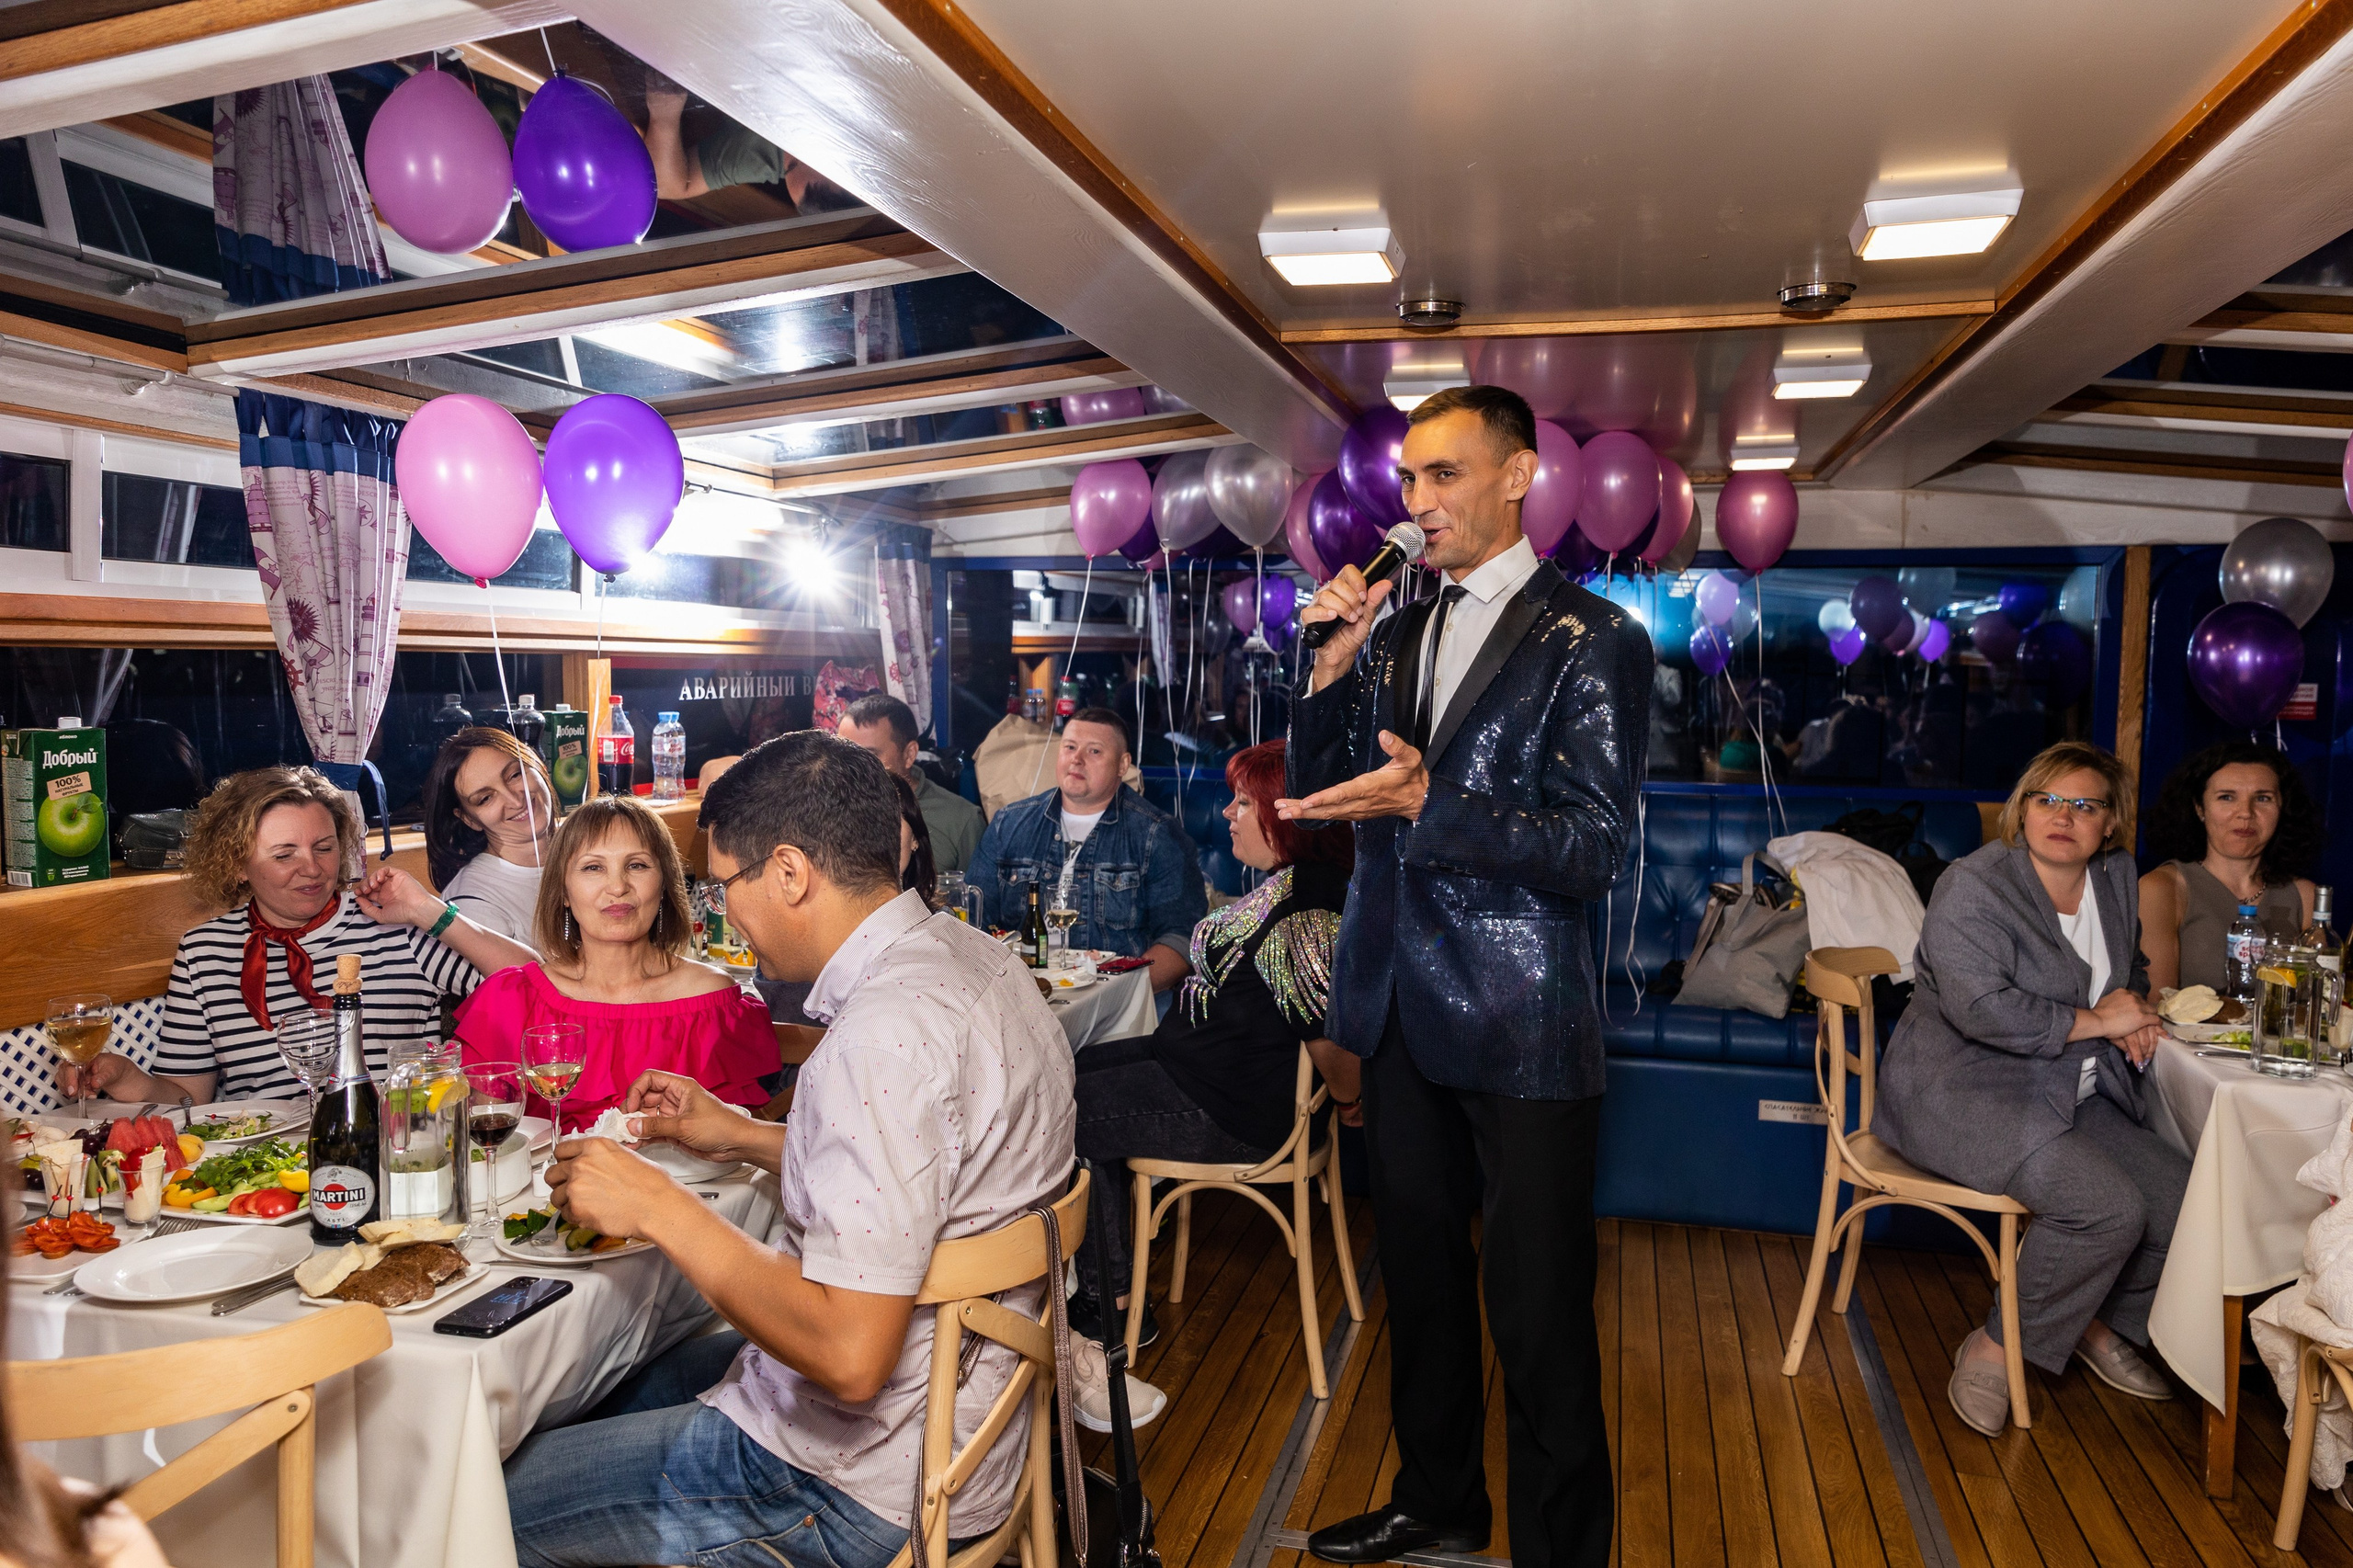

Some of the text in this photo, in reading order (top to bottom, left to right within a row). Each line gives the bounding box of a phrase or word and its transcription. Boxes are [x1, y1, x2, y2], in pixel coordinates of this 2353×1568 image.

[556, 724, 585, 738] Добрый
[42, 748, 97, 769] Добрый
[55, 775, 82, 789] 100%
[313, 1188, 364, 1202] MARTINI
